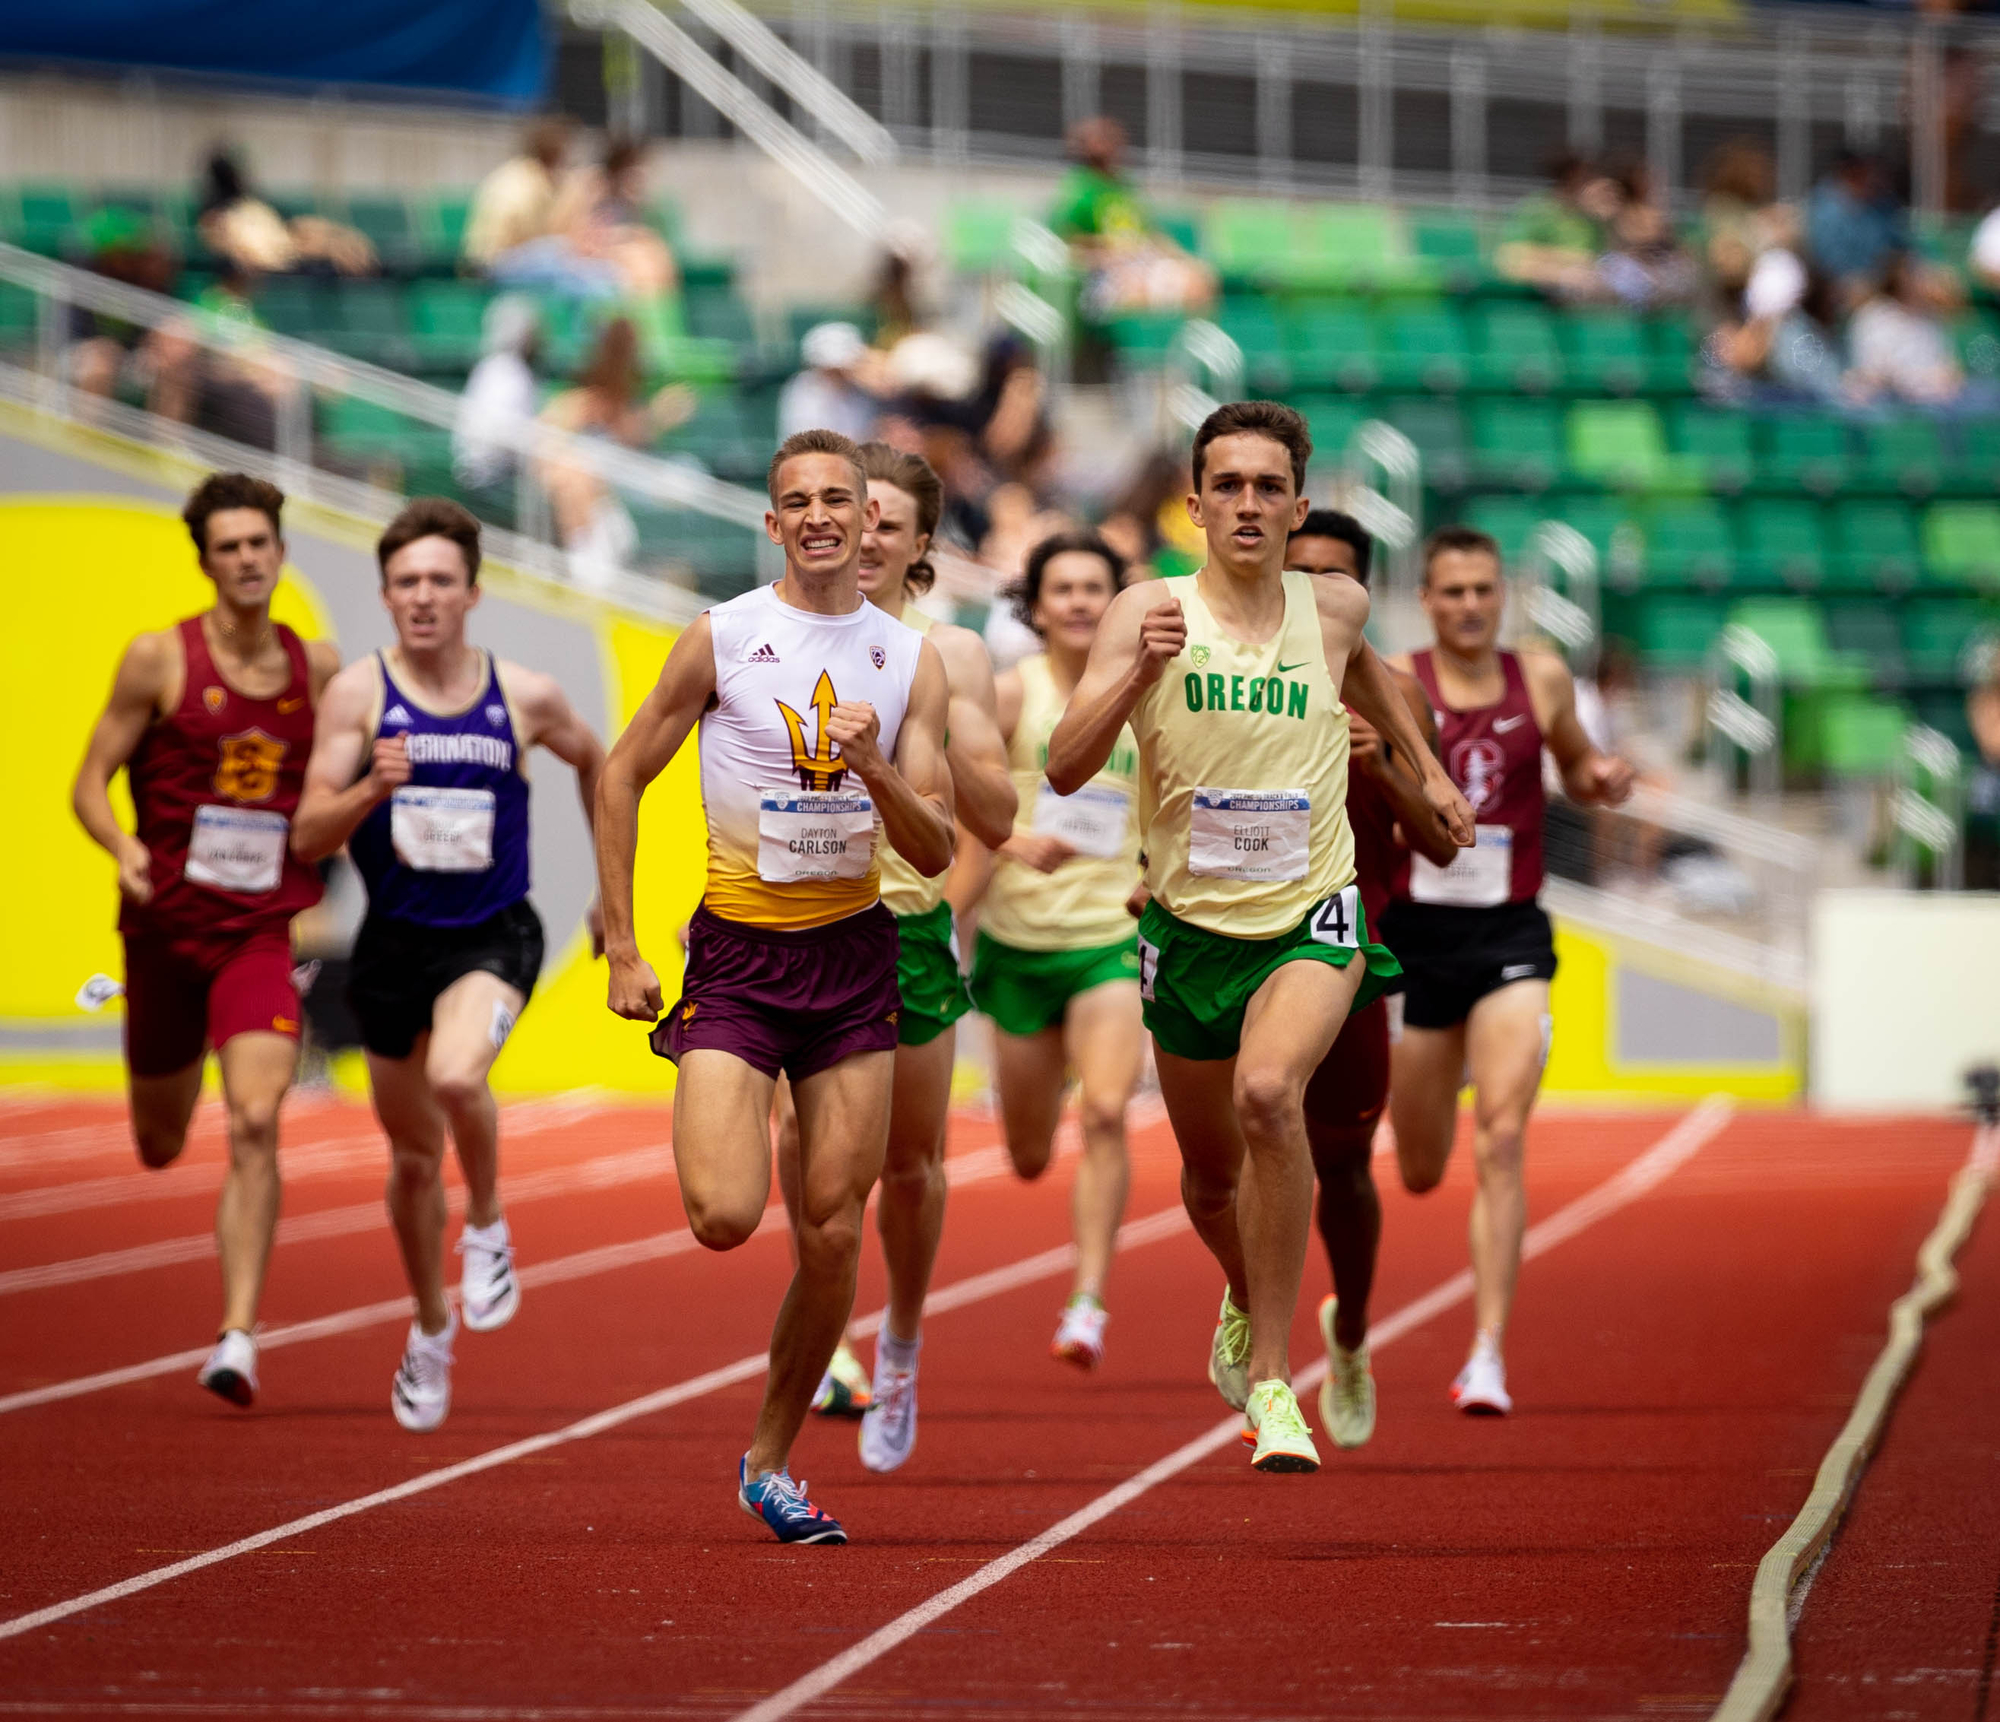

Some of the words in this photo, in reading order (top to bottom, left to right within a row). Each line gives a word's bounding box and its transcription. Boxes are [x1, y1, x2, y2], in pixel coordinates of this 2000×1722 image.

[748, 655, 781, 664] adidas
[1184, 671, 1309, 720] OREGON
[796, 801, 862, 813] CHAMPIONSHIPS
[1229, 799, 1299, 811] CHAMPIONSHIPS
[801, 828, 838, 839] DAYTON
[789, 840, 848, 854] CARLSON
[1234, 837, 1270, 852] COOK
[1315, 894, 1349, 944] 4
